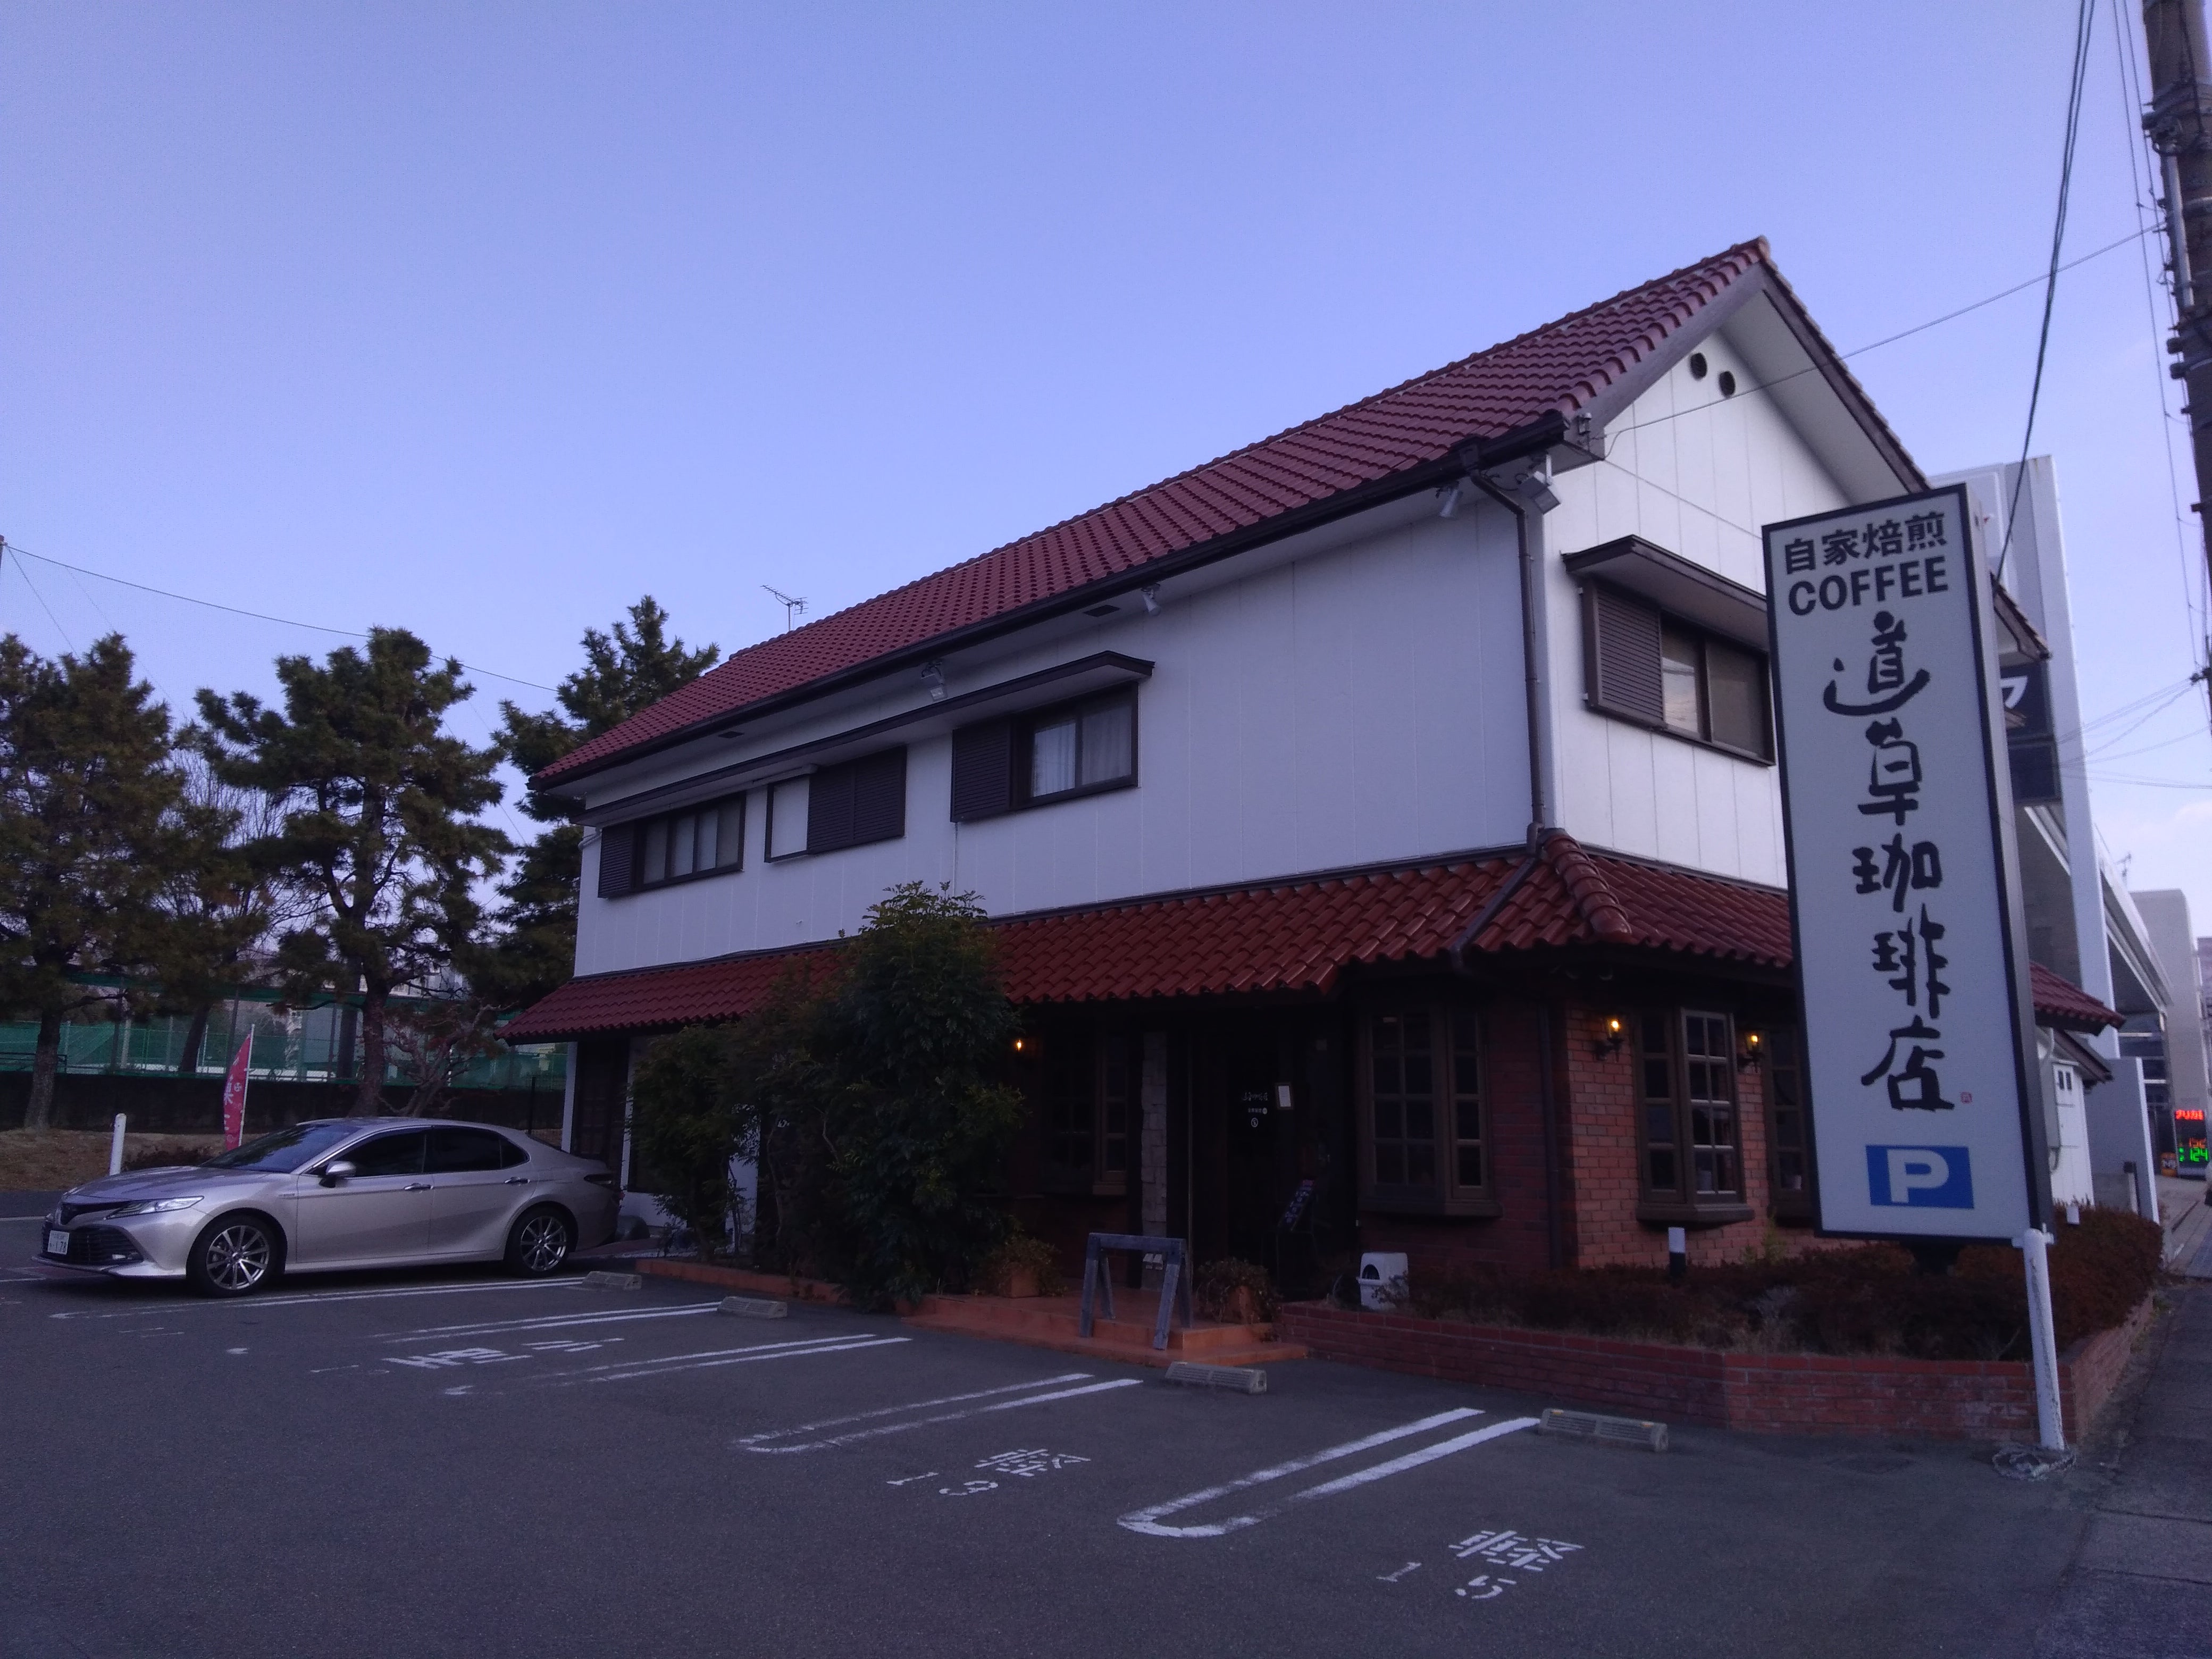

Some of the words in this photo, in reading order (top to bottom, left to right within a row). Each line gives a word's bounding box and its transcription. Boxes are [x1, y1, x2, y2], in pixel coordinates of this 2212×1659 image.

[1784, 511, 1947, 575] 自家焙煎
[1788, 556, 1949, 616] COFFEE
[1823, 610, 1955, 1111] 道草珈琲店
[1887, 1149, 1949, 1204] P
[974, 1448, 1091, 1477] 軽
[1448, 1530, 1585, 1572] 軽
[1376, 1561, 1517, 1599] 15
